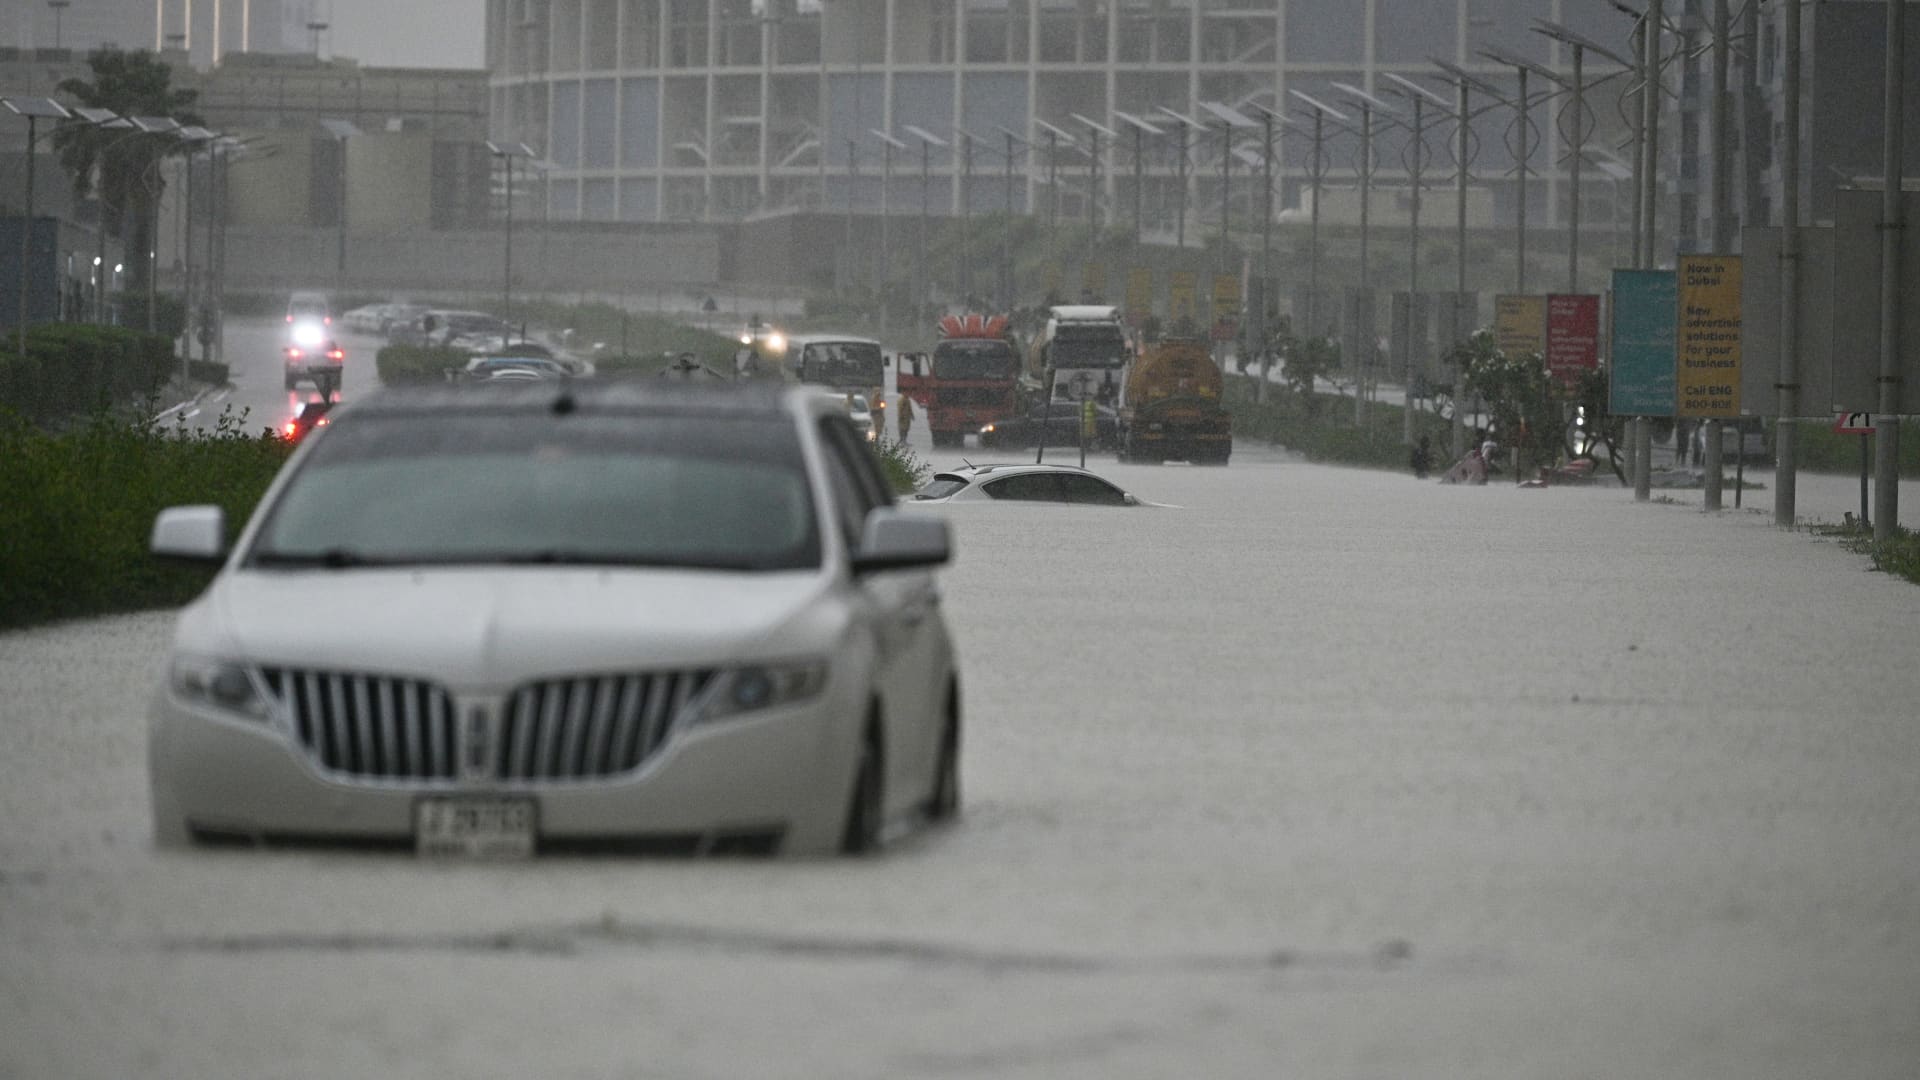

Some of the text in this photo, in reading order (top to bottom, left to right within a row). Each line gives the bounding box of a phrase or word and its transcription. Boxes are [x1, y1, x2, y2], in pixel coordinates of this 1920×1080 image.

[1687, 263, 1725, 273] Now in
[1687, 275, 1721, 286] Dubai
[1687, 305, 1711, 316] New
[1687, 331, 1739, 341] solutions
[1686, 344, 1733, 357] for your
[1686, 357, 1736, 368] business
[1685, 385, 1733, 396] Call ENG
